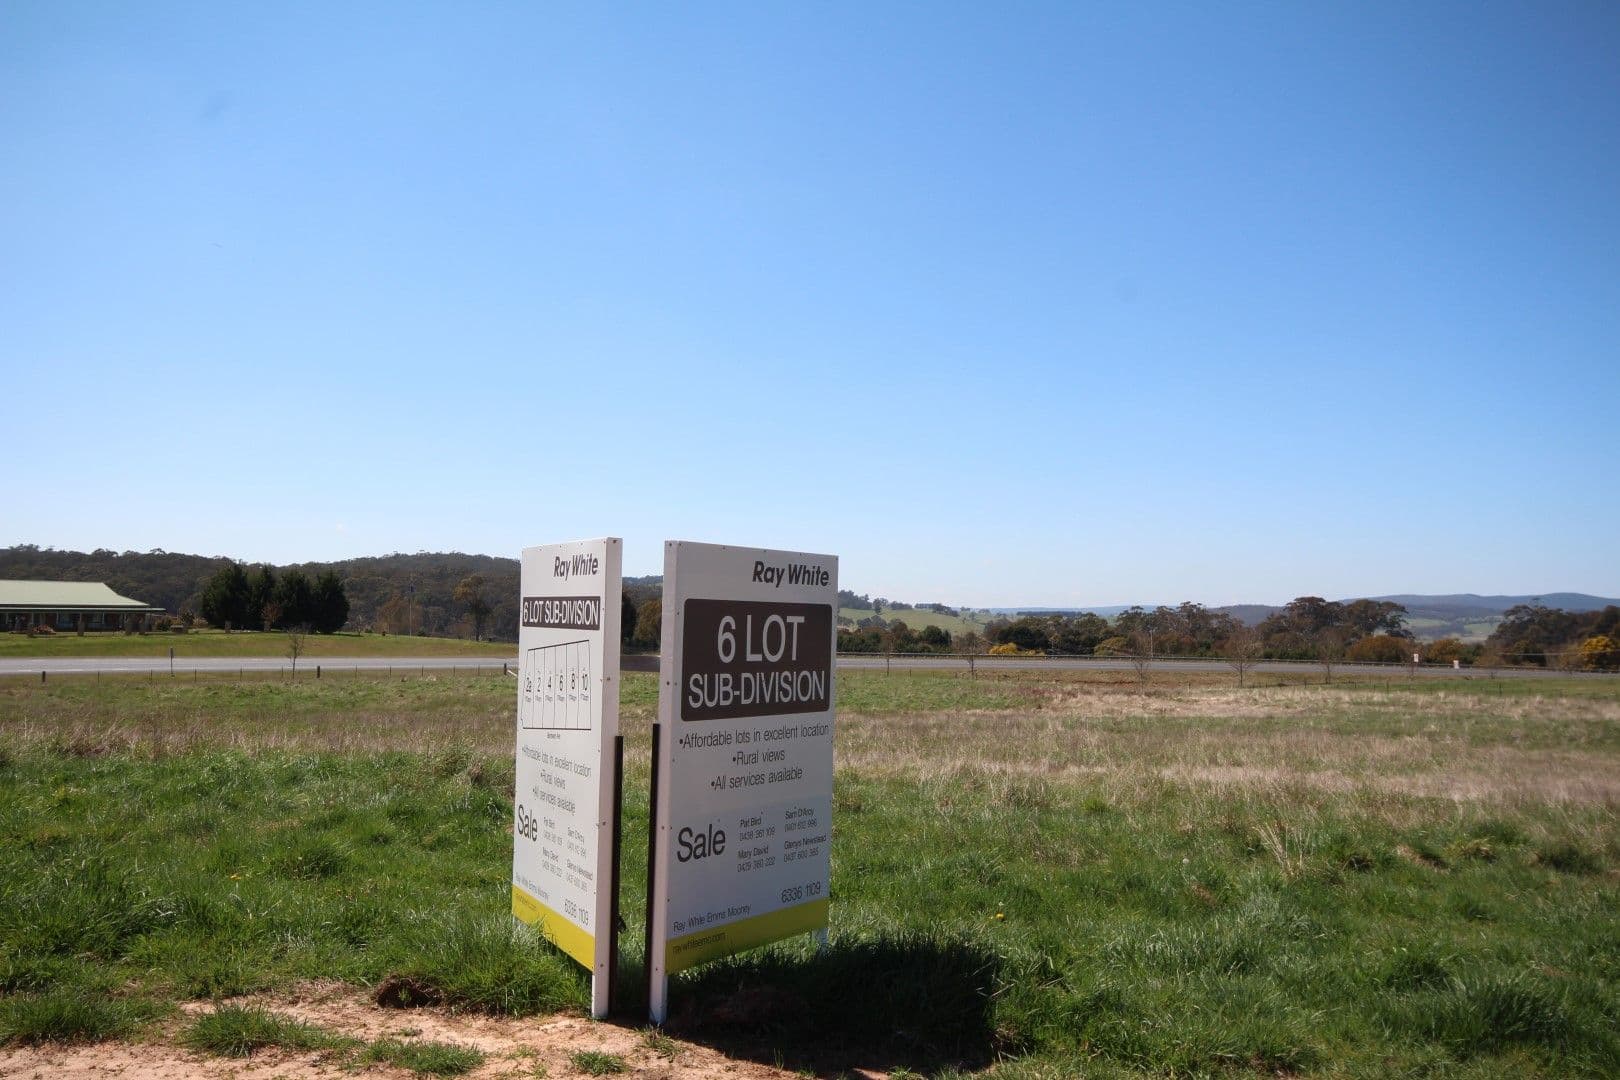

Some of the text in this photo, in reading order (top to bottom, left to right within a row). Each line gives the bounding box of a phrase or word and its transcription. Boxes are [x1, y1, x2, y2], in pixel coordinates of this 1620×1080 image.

[553, 553, 599, 581] Ray White
[752, 560, 829, 588] Ray White
[523, 600, 599, 626] 6 LOT SUB-DIVISION
[688, 614, 825, 709] 6 LOT SUB-DIVISION
[735, 729, 750, 744] lots
[753, 728, 761, 742] in
[764, 725, 798, 742] excellent
[801, 724, 829, 738] location
[762, 749, 786, 763] views
[730, 772, 765, 789] services
[768, 767, 803, 783] available
[518, 804, 538, 842] Sale
[677, 823, 726, 863] Sale
